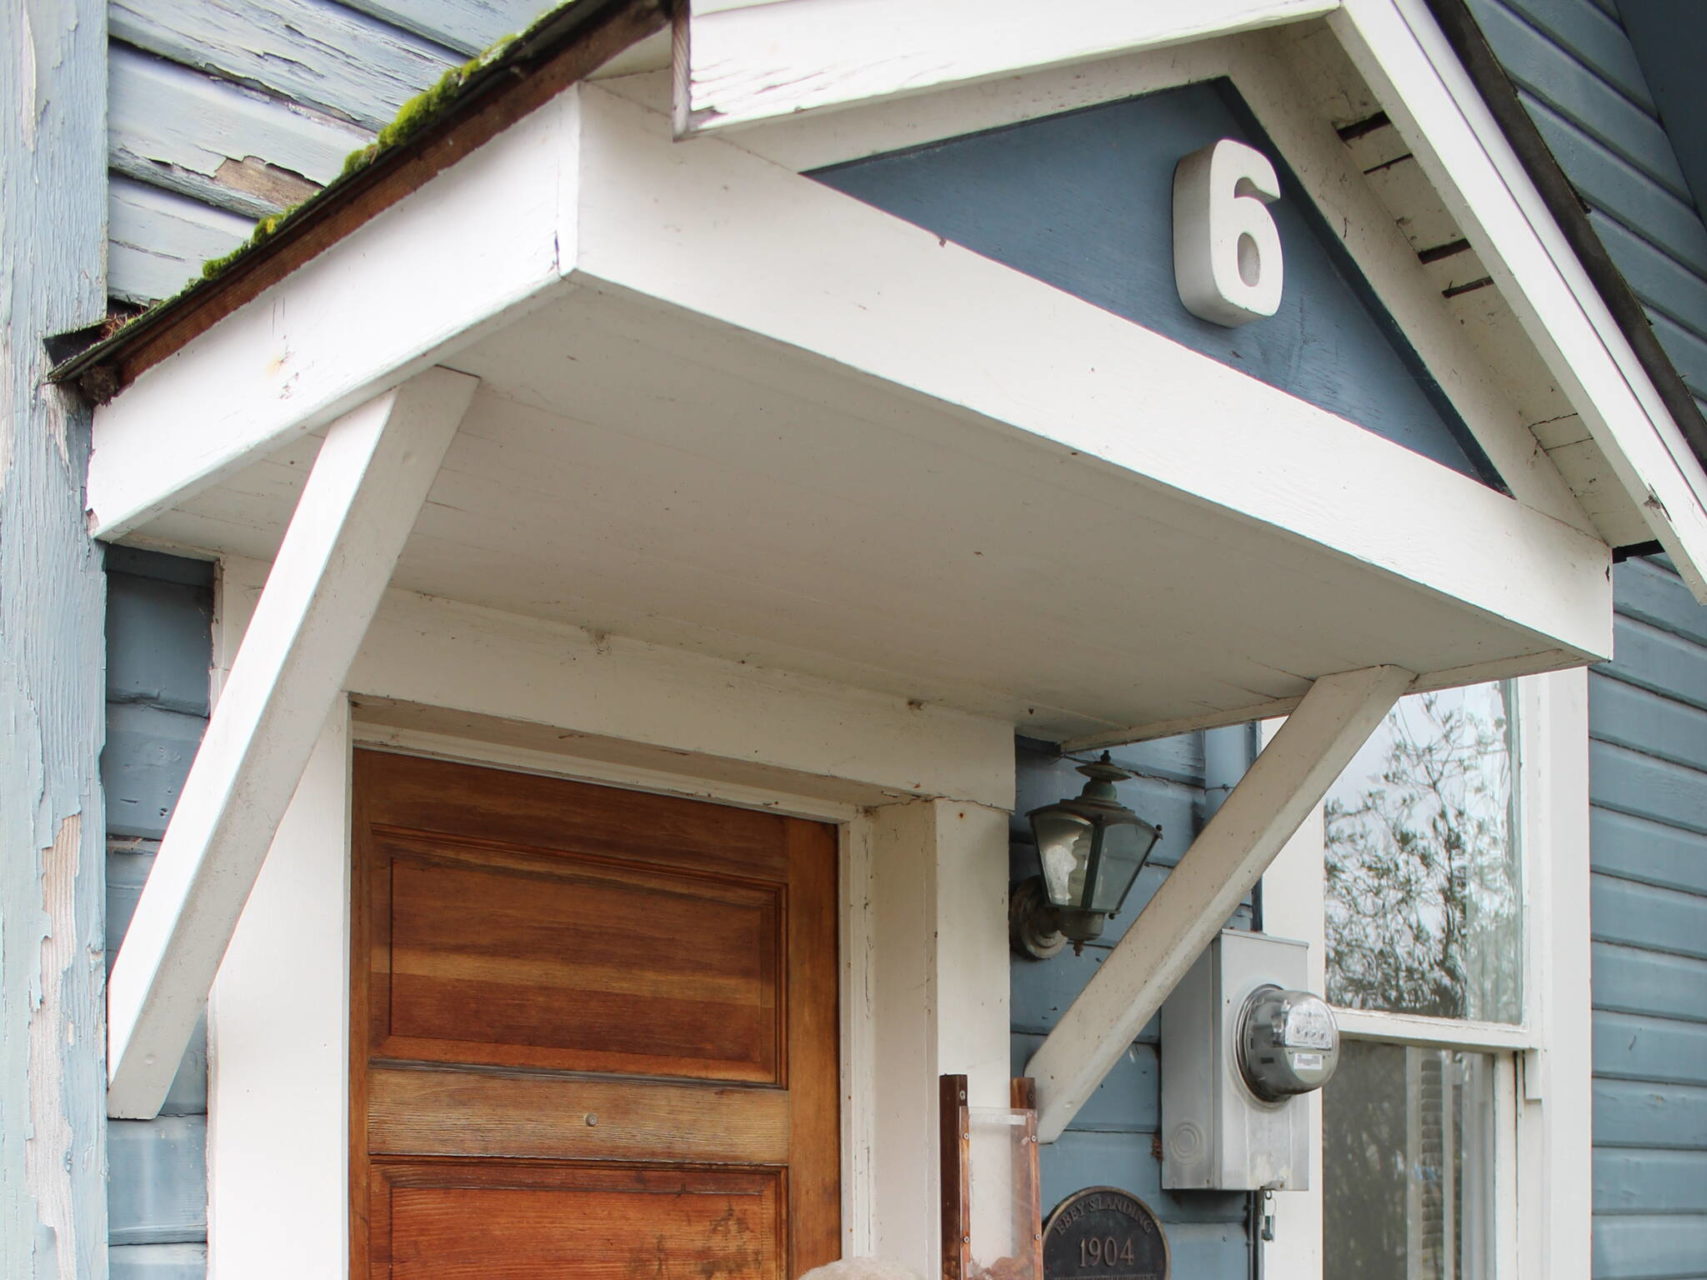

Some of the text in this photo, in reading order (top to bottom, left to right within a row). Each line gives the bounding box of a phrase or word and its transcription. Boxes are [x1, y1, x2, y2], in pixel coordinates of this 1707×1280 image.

[1173, 138, 1284, 328] 6
[1098, 1196, 1153, 1233] LANDING
[1080, 1236, 1134, 1268] 1904
